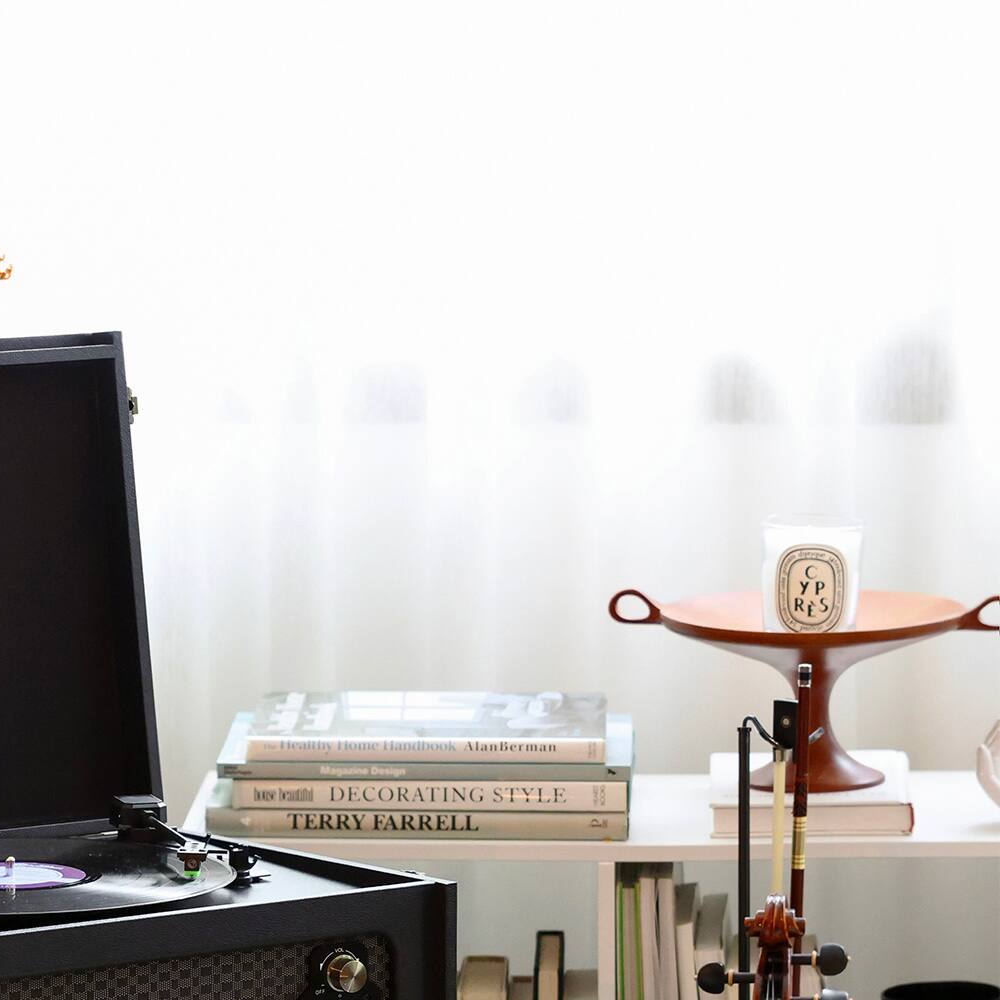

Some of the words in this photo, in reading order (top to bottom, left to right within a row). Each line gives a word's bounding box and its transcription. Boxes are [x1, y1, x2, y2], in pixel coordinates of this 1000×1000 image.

[383, 739, 457, 751] Handbook
[370, 766, 406, 777] Design
[330, 786, 485, 803] DECORATING
[492, 786, 568, 803] STYLE
[287, 813, 366, 831] TERRY
[372, 813, 480, 832] FARRELL
